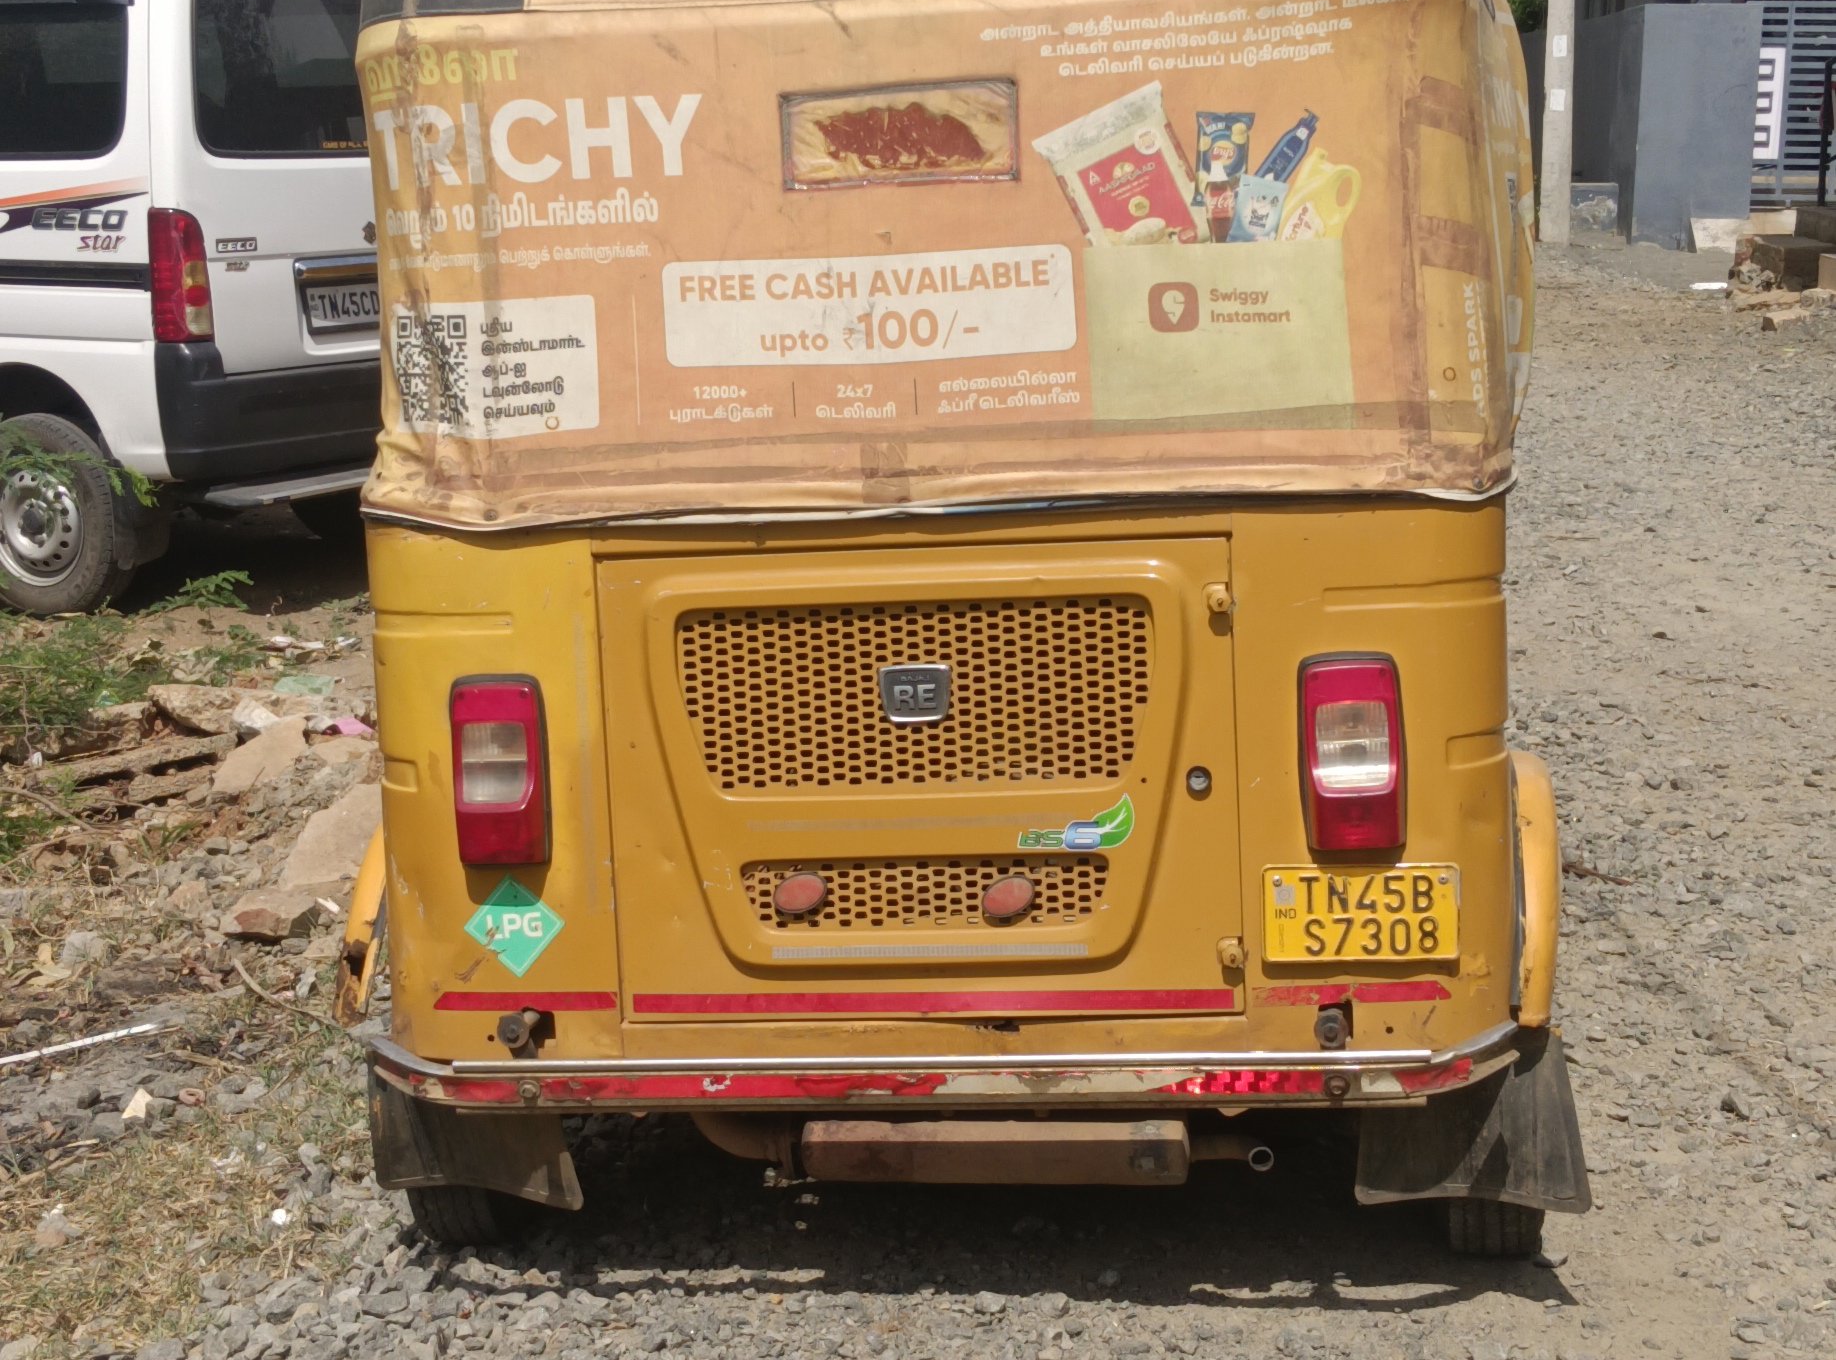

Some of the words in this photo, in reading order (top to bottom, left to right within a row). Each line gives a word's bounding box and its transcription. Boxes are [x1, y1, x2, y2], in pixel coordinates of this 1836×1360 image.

[980, 24, 1060, 41] அன்றாட
[1040, 39, 1107, 57] உங்கள்
[1059, 55, 1142, 76] டெலிவரி
[373, 94, 703, 191] TRICHY
[32, 208, 128, 231] EECO
[452, 203, 475, 231] 10
[77, 235, 126, 252] star
[217, 240, 256, 252] EECO
[679, 273, 756, 303] FREE
[765, 270, 858, 300] CASH
[868, 257, 1052, 298] AVAILABLE
[1209, 288, 1269, 306] Swiggy
[480, 317, 513, 337] புதிய
[1210, 310, 1291, 323] Instamart
[1463, 283, 1481, 362] SPARK
[760, 329, 829, 358] upto
[693, 384, 748, 399] 12000+
[837, 384, 873, 399] 24x7
[815, 401, 896, 420] டெலிவரி
[893, 683, 937, 711] RE
[1018, 820, 1101, 851] BS6
[1299, 873, 1435, 915] TN45B
[1275, 908, 1297, 919] IND
[486, 911, 543, 939] LPG
[1304, 916, 1440, 956] S7308
